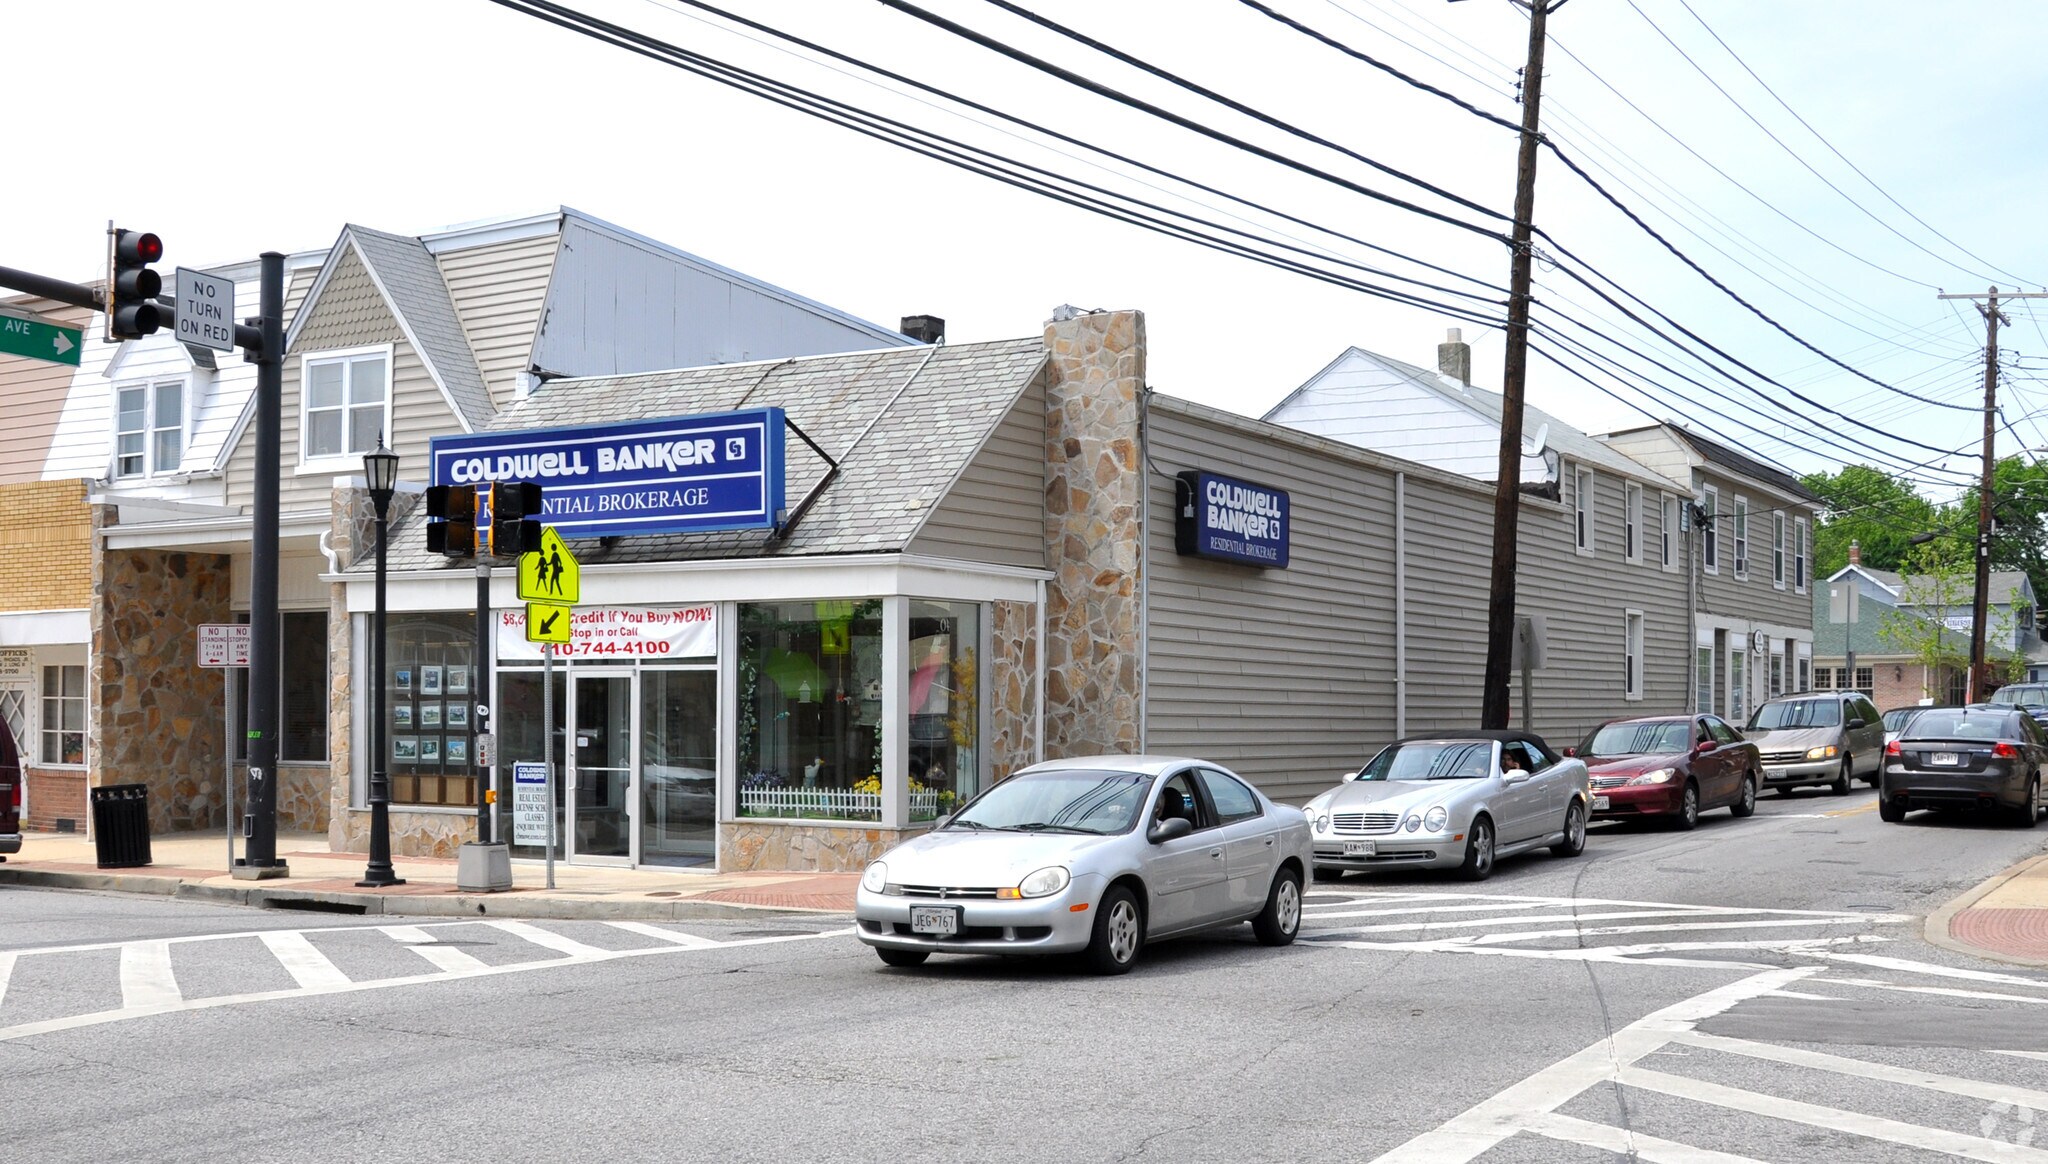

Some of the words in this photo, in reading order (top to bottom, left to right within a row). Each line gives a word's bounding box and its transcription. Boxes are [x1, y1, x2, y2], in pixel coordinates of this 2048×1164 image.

[194, 281, 216, 298] NO
[188, 299, 222, 320] TURN
[5, 319, 31, 335] AVE
[181, 319, 198, 335] ON
[203, 324, 229, 342] RED
[451, 450, 590, 483] COLDWELL
[597, 438, 716, 472] BANKER
[483, 496, 595, 520] RNTIAL
[597, 487, 710, 513] BROKERAGE
[1206, 480, 1281, 519] COLDWELL
[1207, 504, 1269, 540] BANKER
[1210, 536, 1245, 554] RESIDENTIAL
[1245, 543, 1277, 560] BROKERAGE
[620, 610, 643, 624] You
[647, 609, 671, 626] Buy
[673, 606, 713, 624] NOW!
[208, 627, 220, 636] NO
[236, 627, 248, 636] NO
[570, 627, 592, 639] Stop
[595, 626, 604, 637] in
[607, 627, 618, 637] or
[619, 626, 639, 637] Call
[519, 793, 531, 802] REAL
[532, 793, 547, 802] ESTAT
[516, 803, 534, 812] LICENSE
[524, 812, 545, 821] CLASSES
[914, 914, 932, 927] JEG
[937, 915, 954, 928] 767
